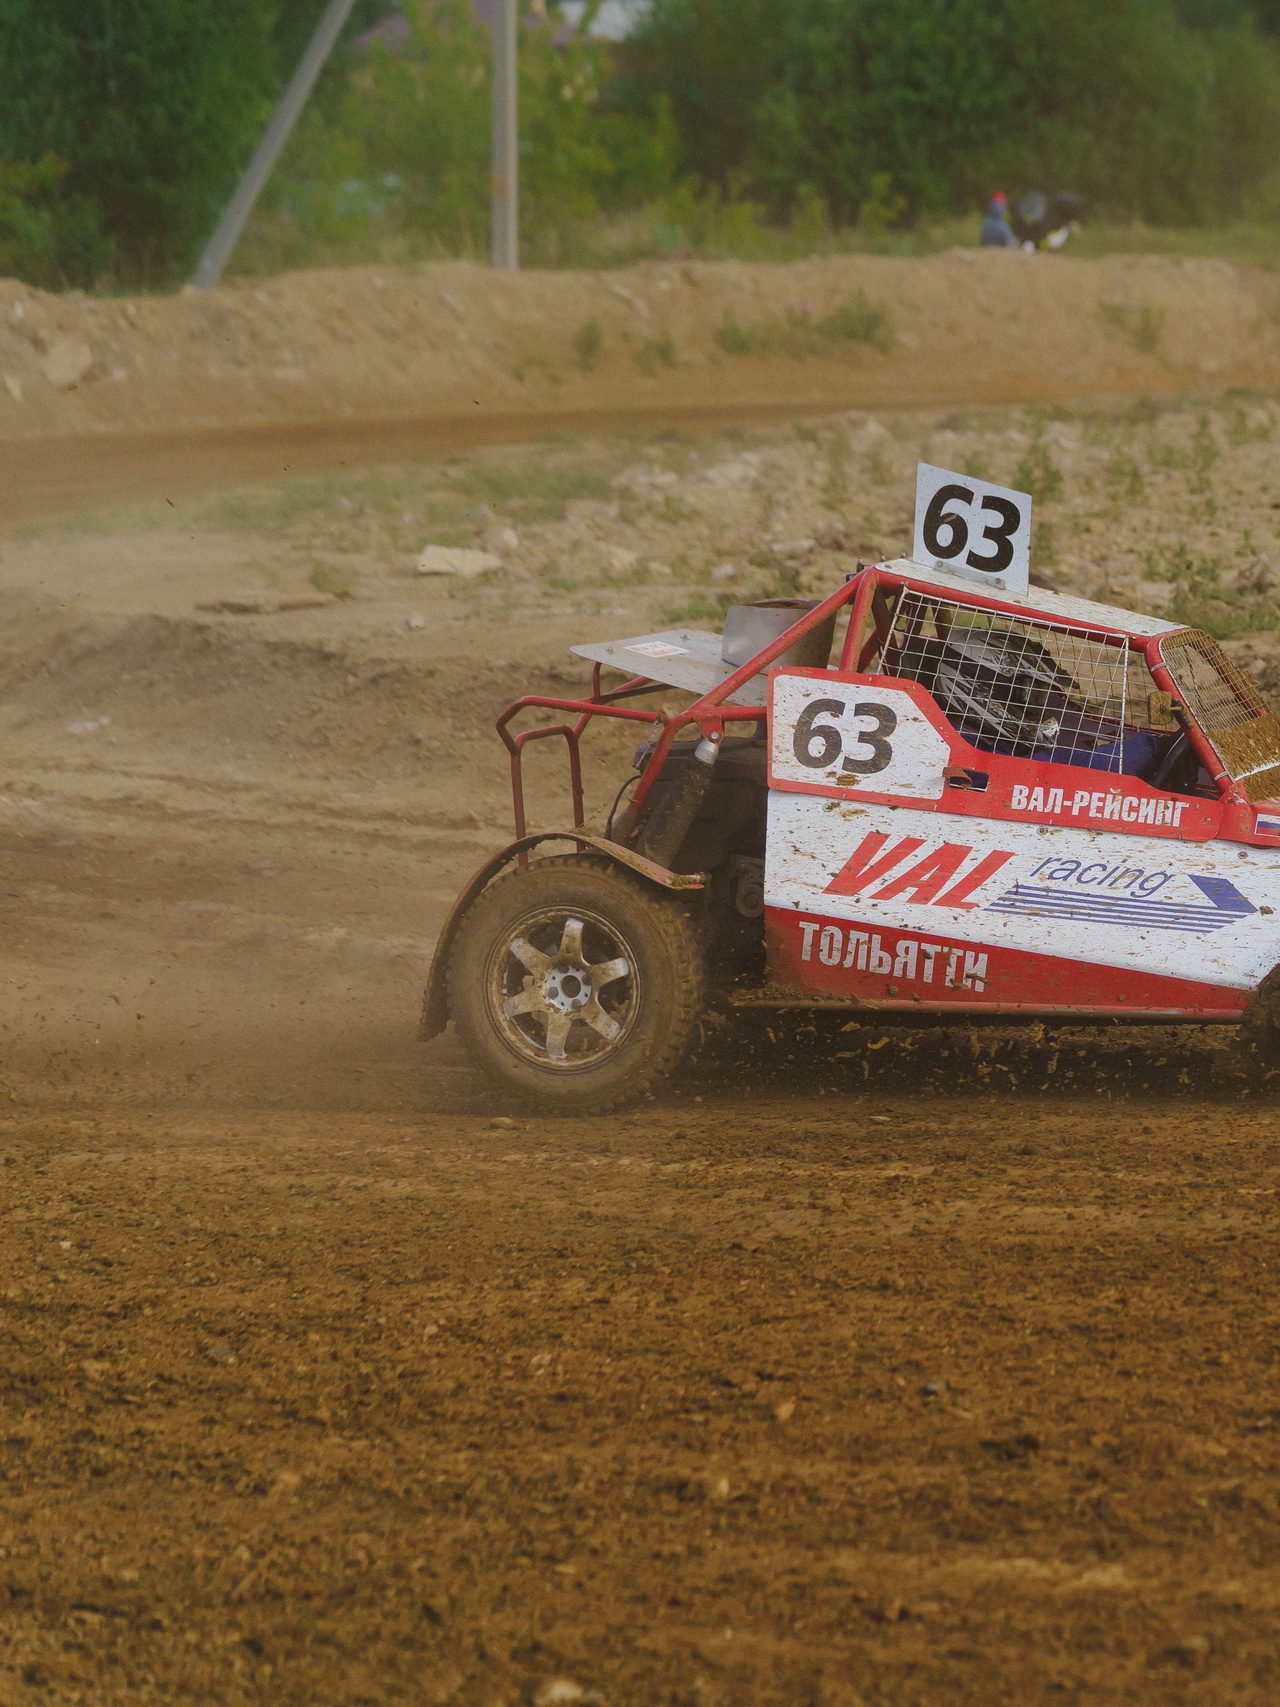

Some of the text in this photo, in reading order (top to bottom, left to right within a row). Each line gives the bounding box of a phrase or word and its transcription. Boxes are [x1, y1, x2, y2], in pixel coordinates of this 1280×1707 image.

[923, 484, 1021, 573] 63
[793, 698, 898, 774] 63
[1011, 784, 1190, 827] ВАЛ-РЕЙСИНГ
[822, 831, 1176, 910] VAL racing
[798, 920, 988, 993] ТОЛЬЯТТИ
